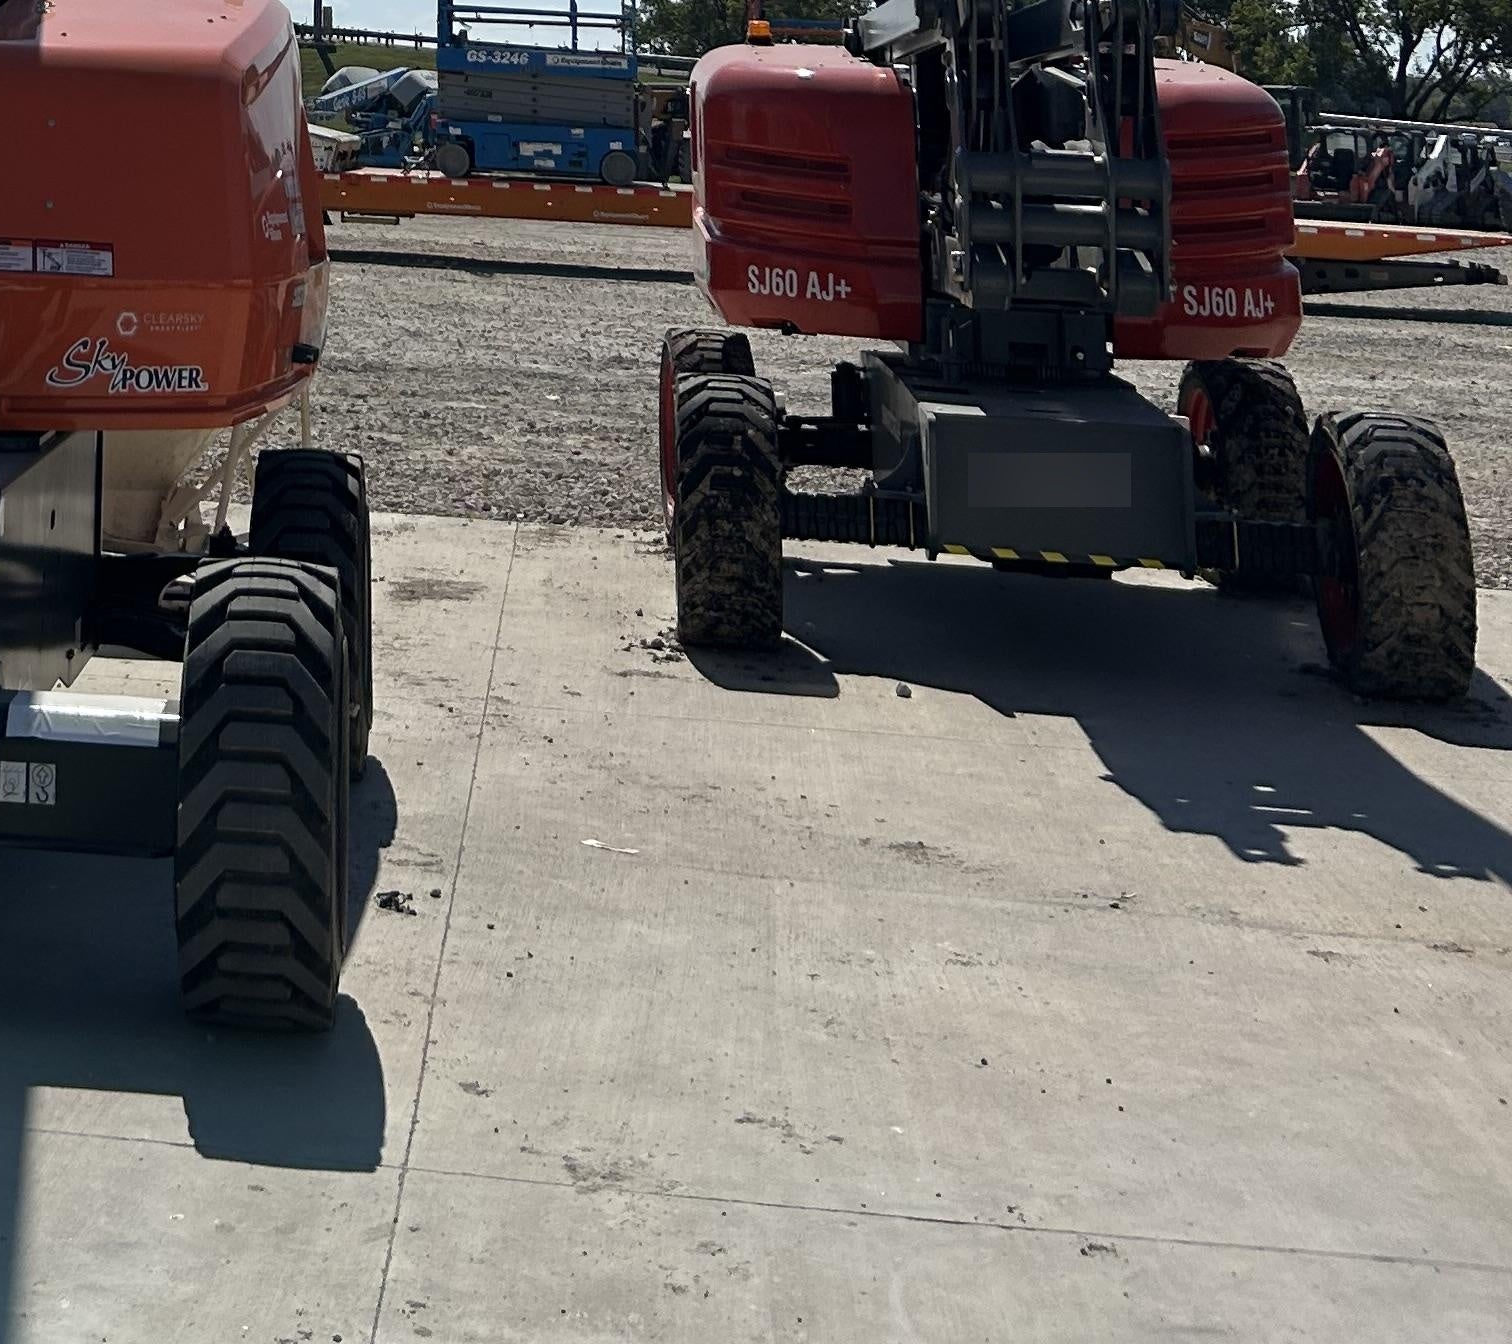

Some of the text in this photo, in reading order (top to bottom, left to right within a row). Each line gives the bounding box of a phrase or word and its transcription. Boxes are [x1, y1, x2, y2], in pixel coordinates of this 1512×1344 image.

[466, 49, 531, 66] GS-3246
[747, 264, 853, 302] SJ60 AJ+
[1183, 284, 1276, 320] SJ60 AJ+
[143, 313, 206, 325] CLEARSKY
